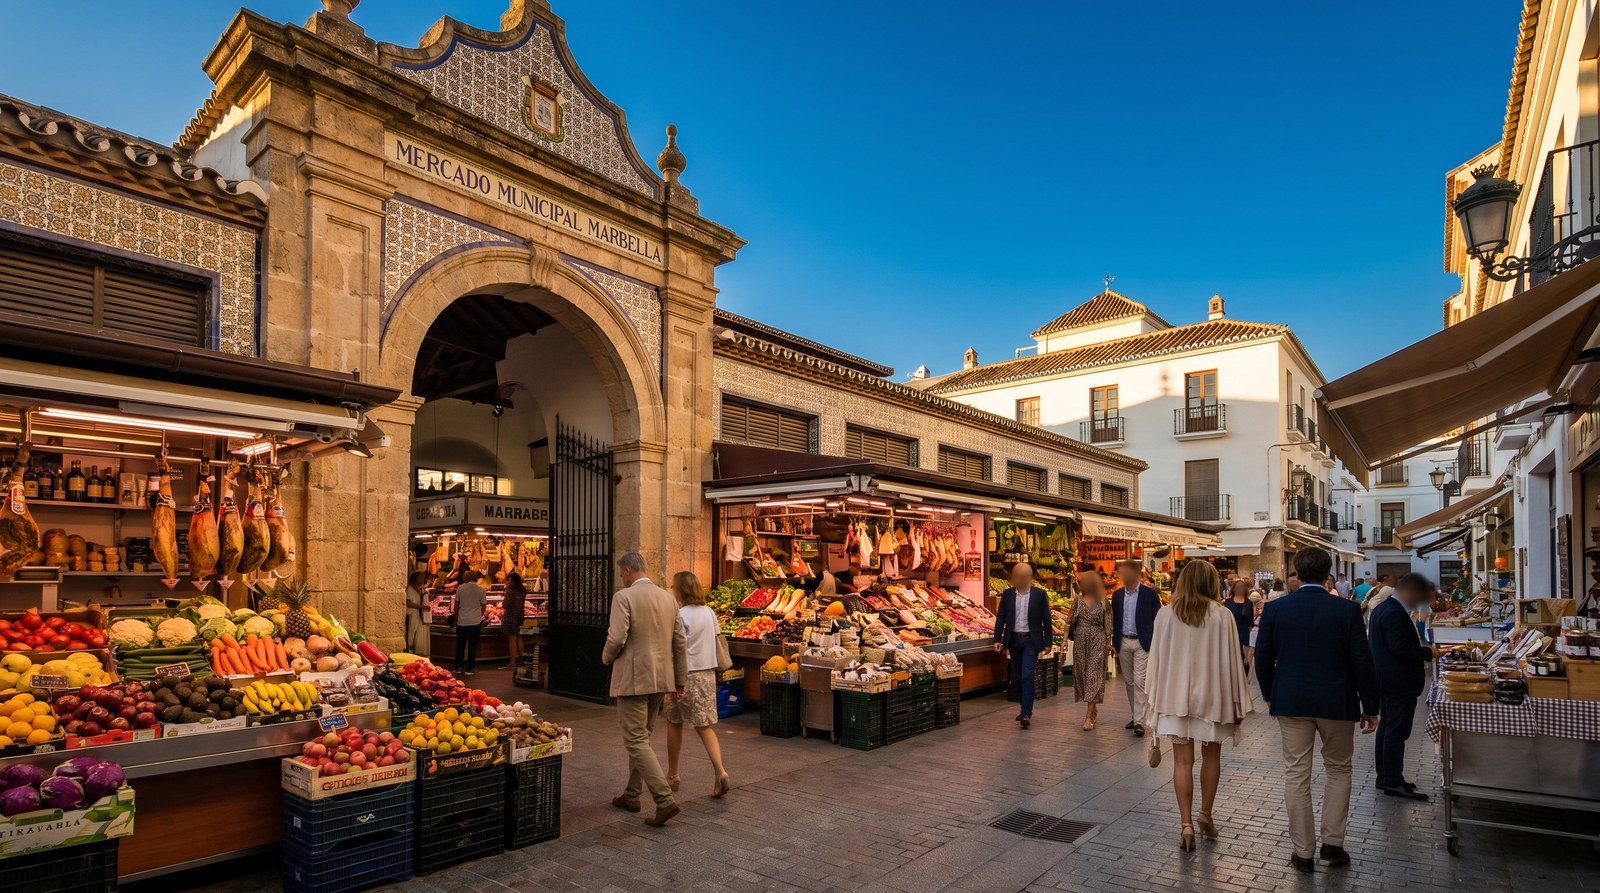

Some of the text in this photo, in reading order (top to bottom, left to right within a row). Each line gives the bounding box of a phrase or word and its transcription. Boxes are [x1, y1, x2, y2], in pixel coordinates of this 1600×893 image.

[396, 139, 661, 263] MERCADO MUNICIPAL MARBELLA
